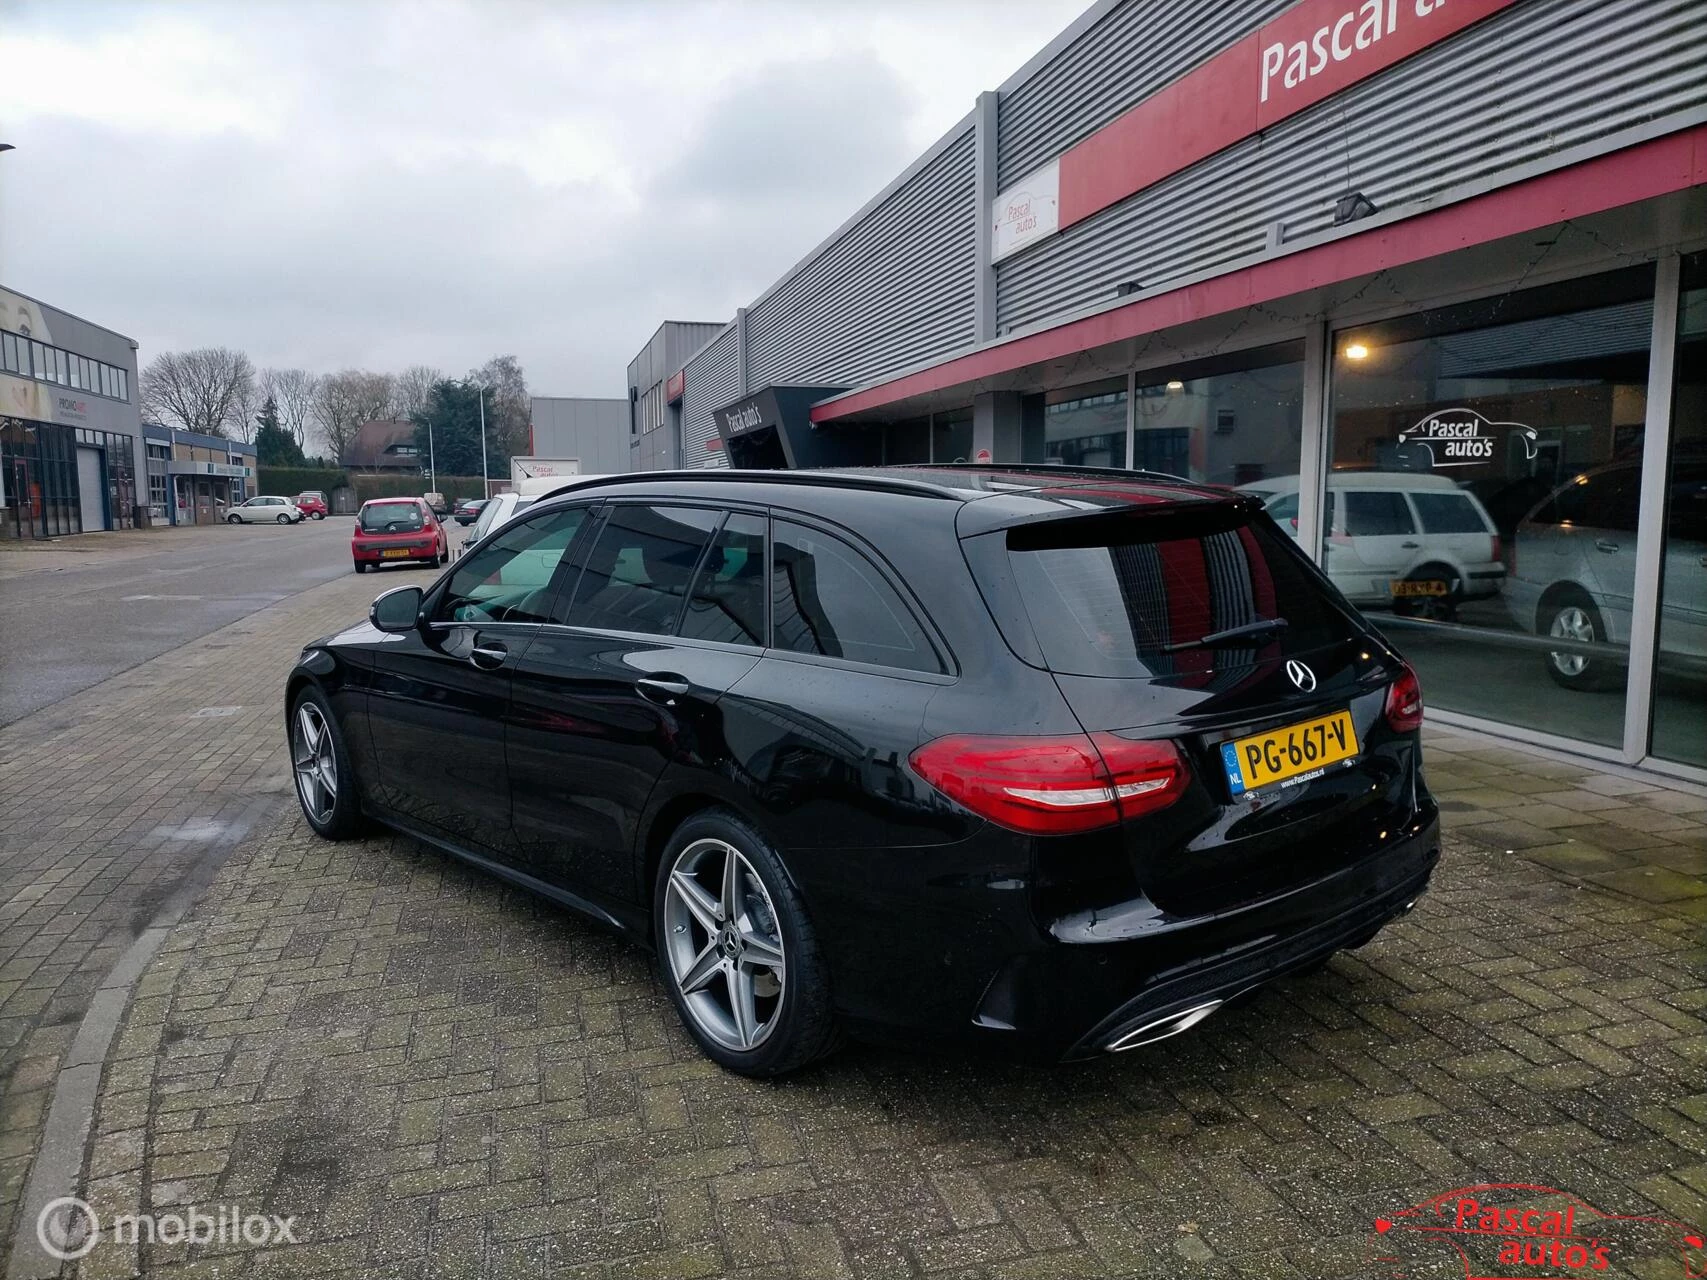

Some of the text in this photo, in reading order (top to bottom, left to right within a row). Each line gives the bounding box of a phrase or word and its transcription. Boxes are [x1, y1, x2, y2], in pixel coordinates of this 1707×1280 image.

[1008, 199, 1031, 220] Pascal
[726, 402, 761, 432] Pascal auto's
[1429, 418, 1478, 437] Pascal
[1445, 438, 1493, 457] auto's
[1245, 719, 1346, 779] PG-667-V
[1229, 773, 1241, 785] NL
